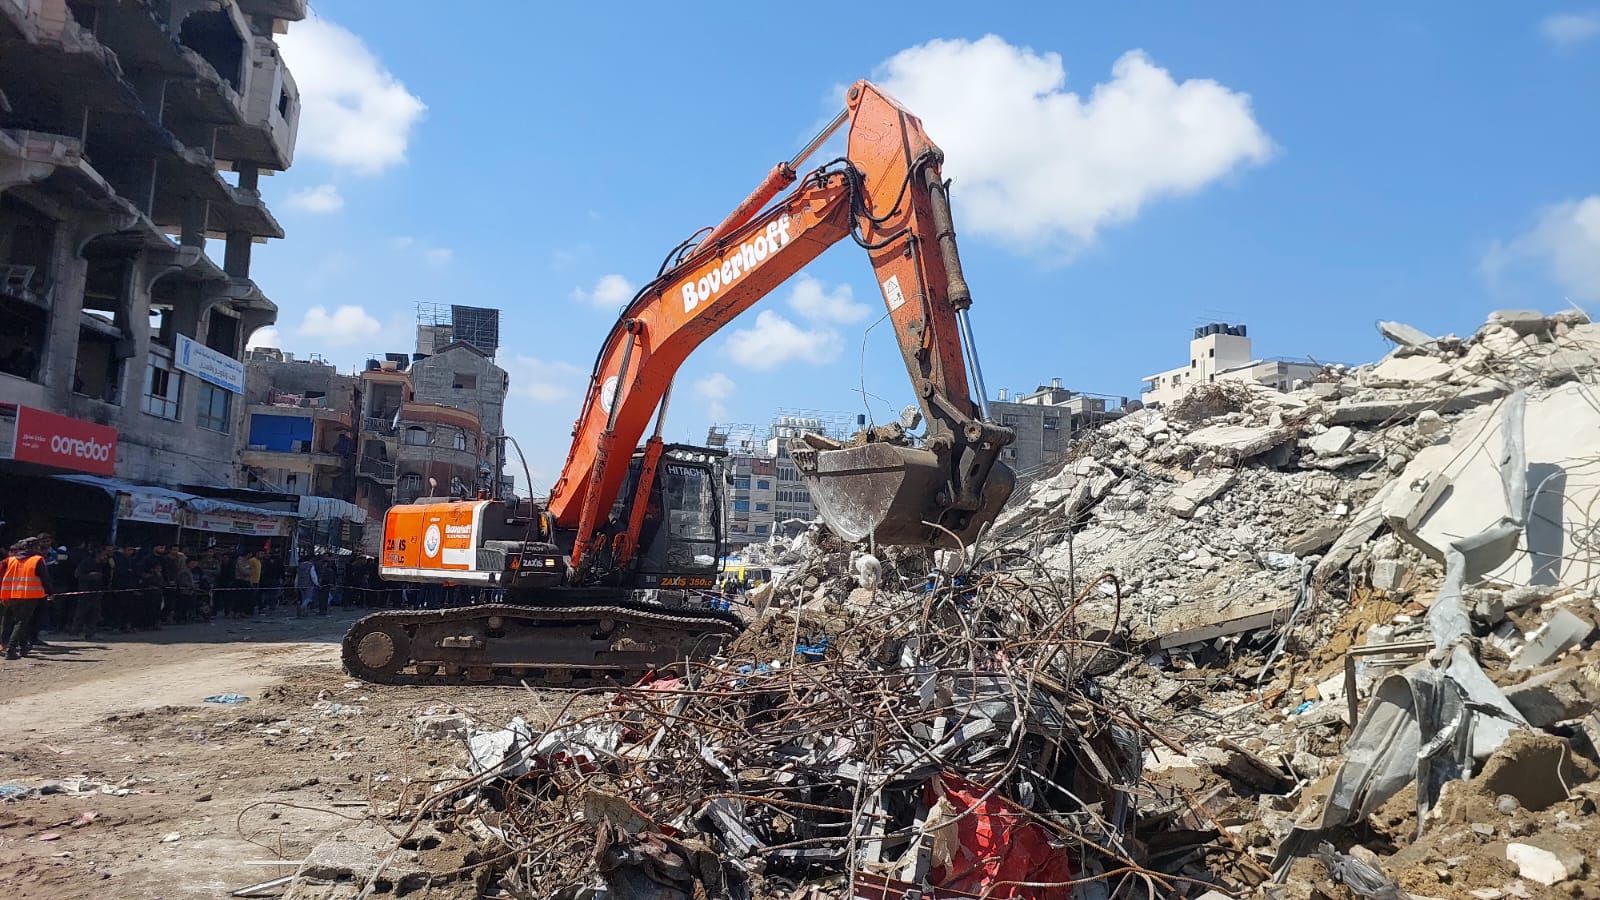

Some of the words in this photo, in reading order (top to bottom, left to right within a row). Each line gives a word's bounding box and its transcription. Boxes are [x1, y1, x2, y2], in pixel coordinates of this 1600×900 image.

[681, 213, 791, 313] Boverhoff
[51, 434, 109, 462] ooredoo
[667, 464, 706, 479] HITACHI
[522, 559, 544, 568] ZAXIS
[660, 576, 687, 587] ZAXIS
[689, 577, 713, 587] 350LC
